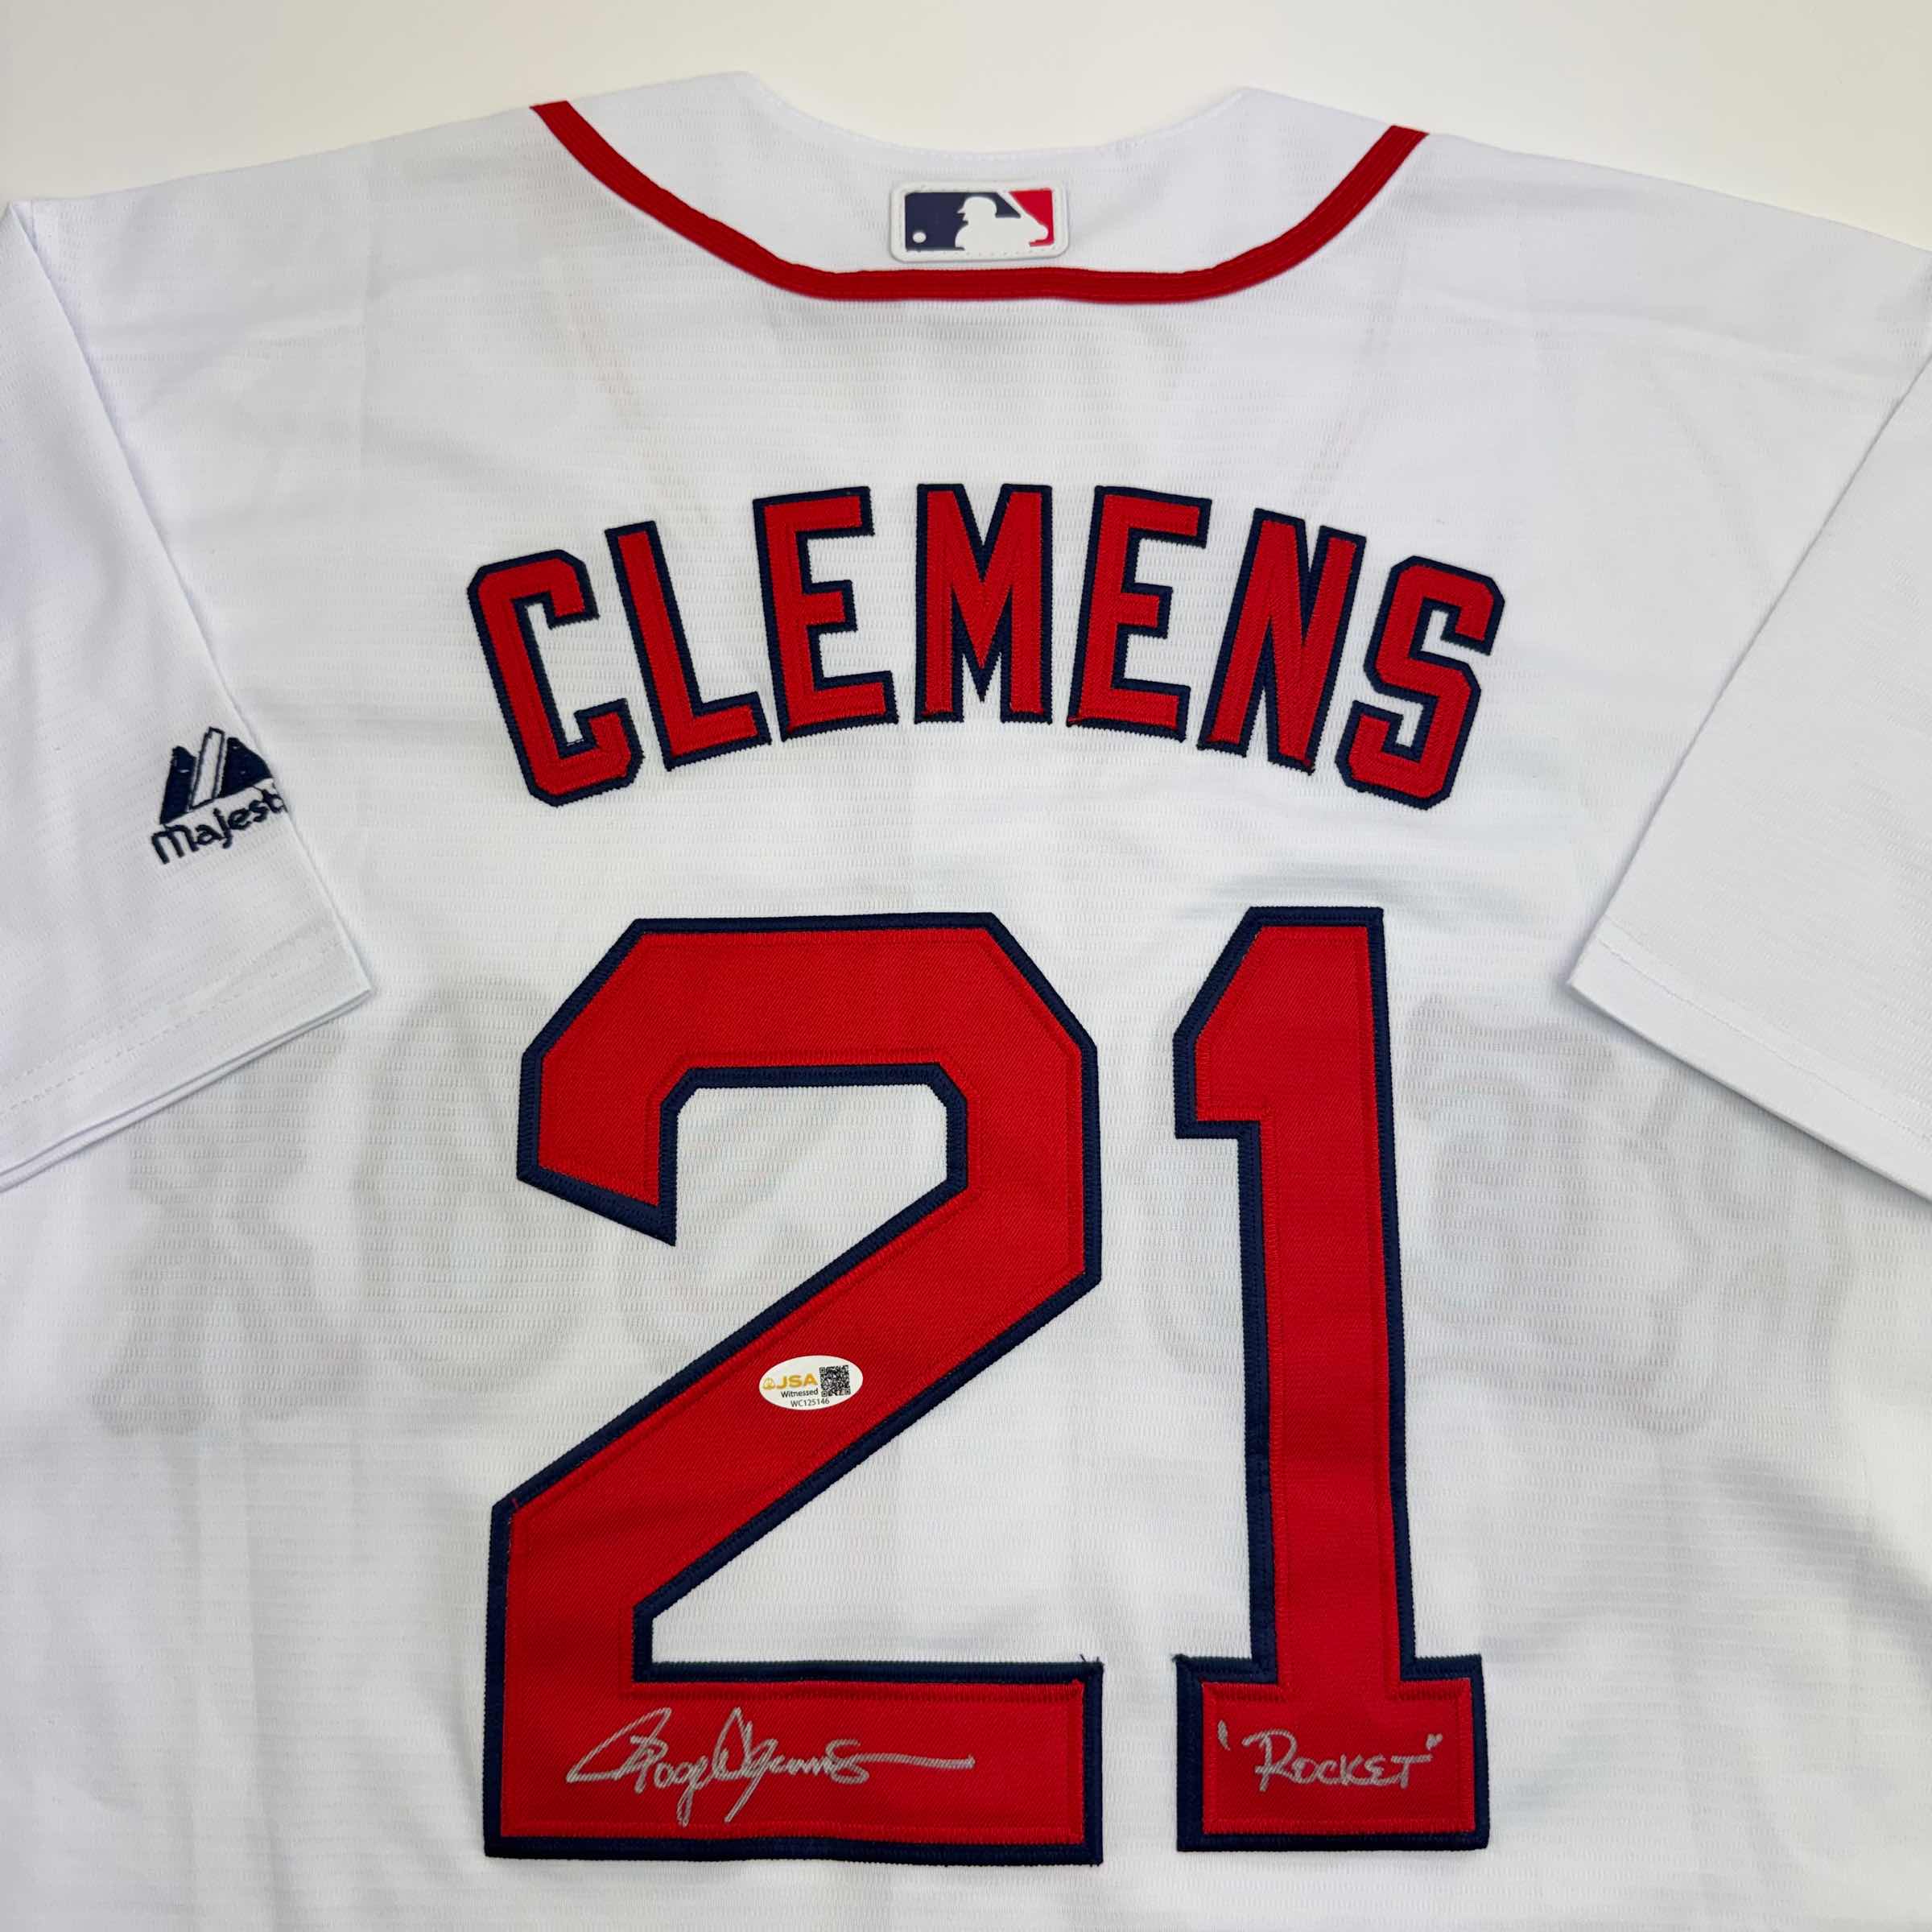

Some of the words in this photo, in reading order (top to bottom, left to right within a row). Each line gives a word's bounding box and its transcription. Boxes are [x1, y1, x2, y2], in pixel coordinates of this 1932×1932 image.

[466, 483, 1505, 811] CLEMENS
[151, 784, 288, 865] Majest
[482, 906, 1490, 1866] 21
[776, 1373, 819, 1390] JSA
[780, 1387, 819, 1398] Witnessed
[791, 1397, 830, 1408] WC125146
